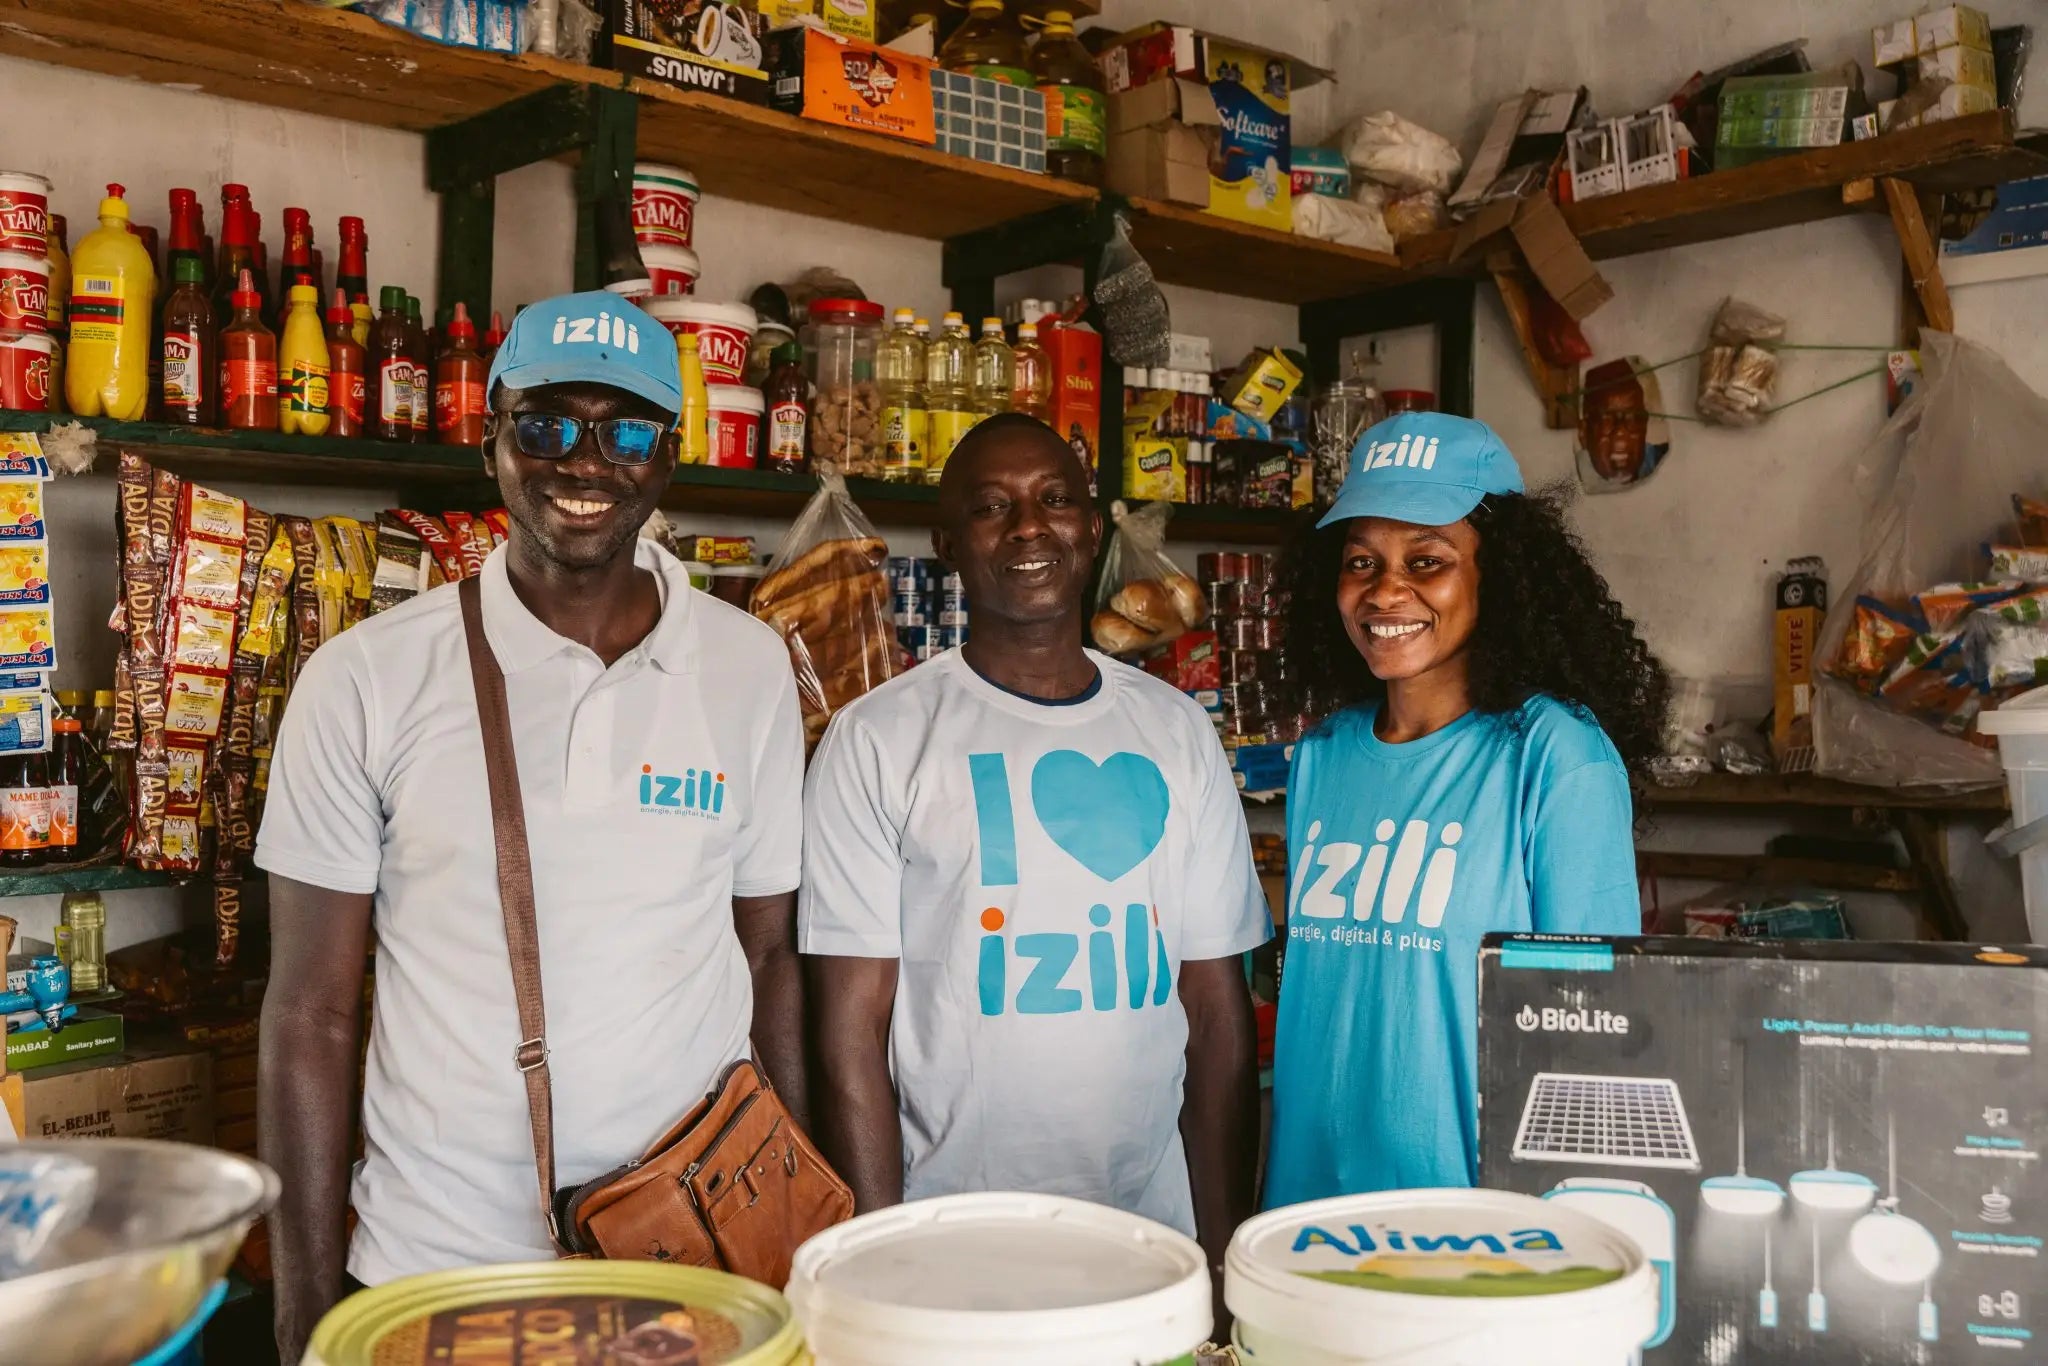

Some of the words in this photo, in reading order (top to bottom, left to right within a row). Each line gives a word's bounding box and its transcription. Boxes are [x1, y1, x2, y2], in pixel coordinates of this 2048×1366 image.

[652, 56, 725, 90] JANUS
[1216, 107, 1279, 139] Softcare
[4, 210, 46, 234] TAMA
[636, 202, 684, 230] TAMA
[553, 312, 639, 354] izili
[776, 410, 804, 423] TAMA
[1363, 434, 1439, 473] izili
[124, 482, 149, 538] ADJA
[409, 513, 448, 544] ADJA
[300, 542, 315, 593] ADJA
[129, 580, 154, 635] ADJA
[112, 689, 135, 742] ADJA
[231, 703, 253, 753] ADJA
[9, 791, 38, 801] MAME
[146, 776, 166, 831] ADJA
[640, 764, 725, 813] izili
[968, 752, 1018, 886] I
[1289, 818, 1463, 928] izili
[219, 886, 240, 941] ADJA
[1290, 924, 1326, 943] ergie,
[1331, 926, 1378, 946] digital
[1382, 931, 1393, 945] &
[1400, 932, 1442, 951] plus
[1542, 1008, 1629, 1034] BioLite
[6, 1041, 49, 1055] SHABAB
[66, 1040, 93, 1052] Sanitary
[94, 1035, 116, 1046] Shaver
[1292, 1223, 1565, 1257] Alima
